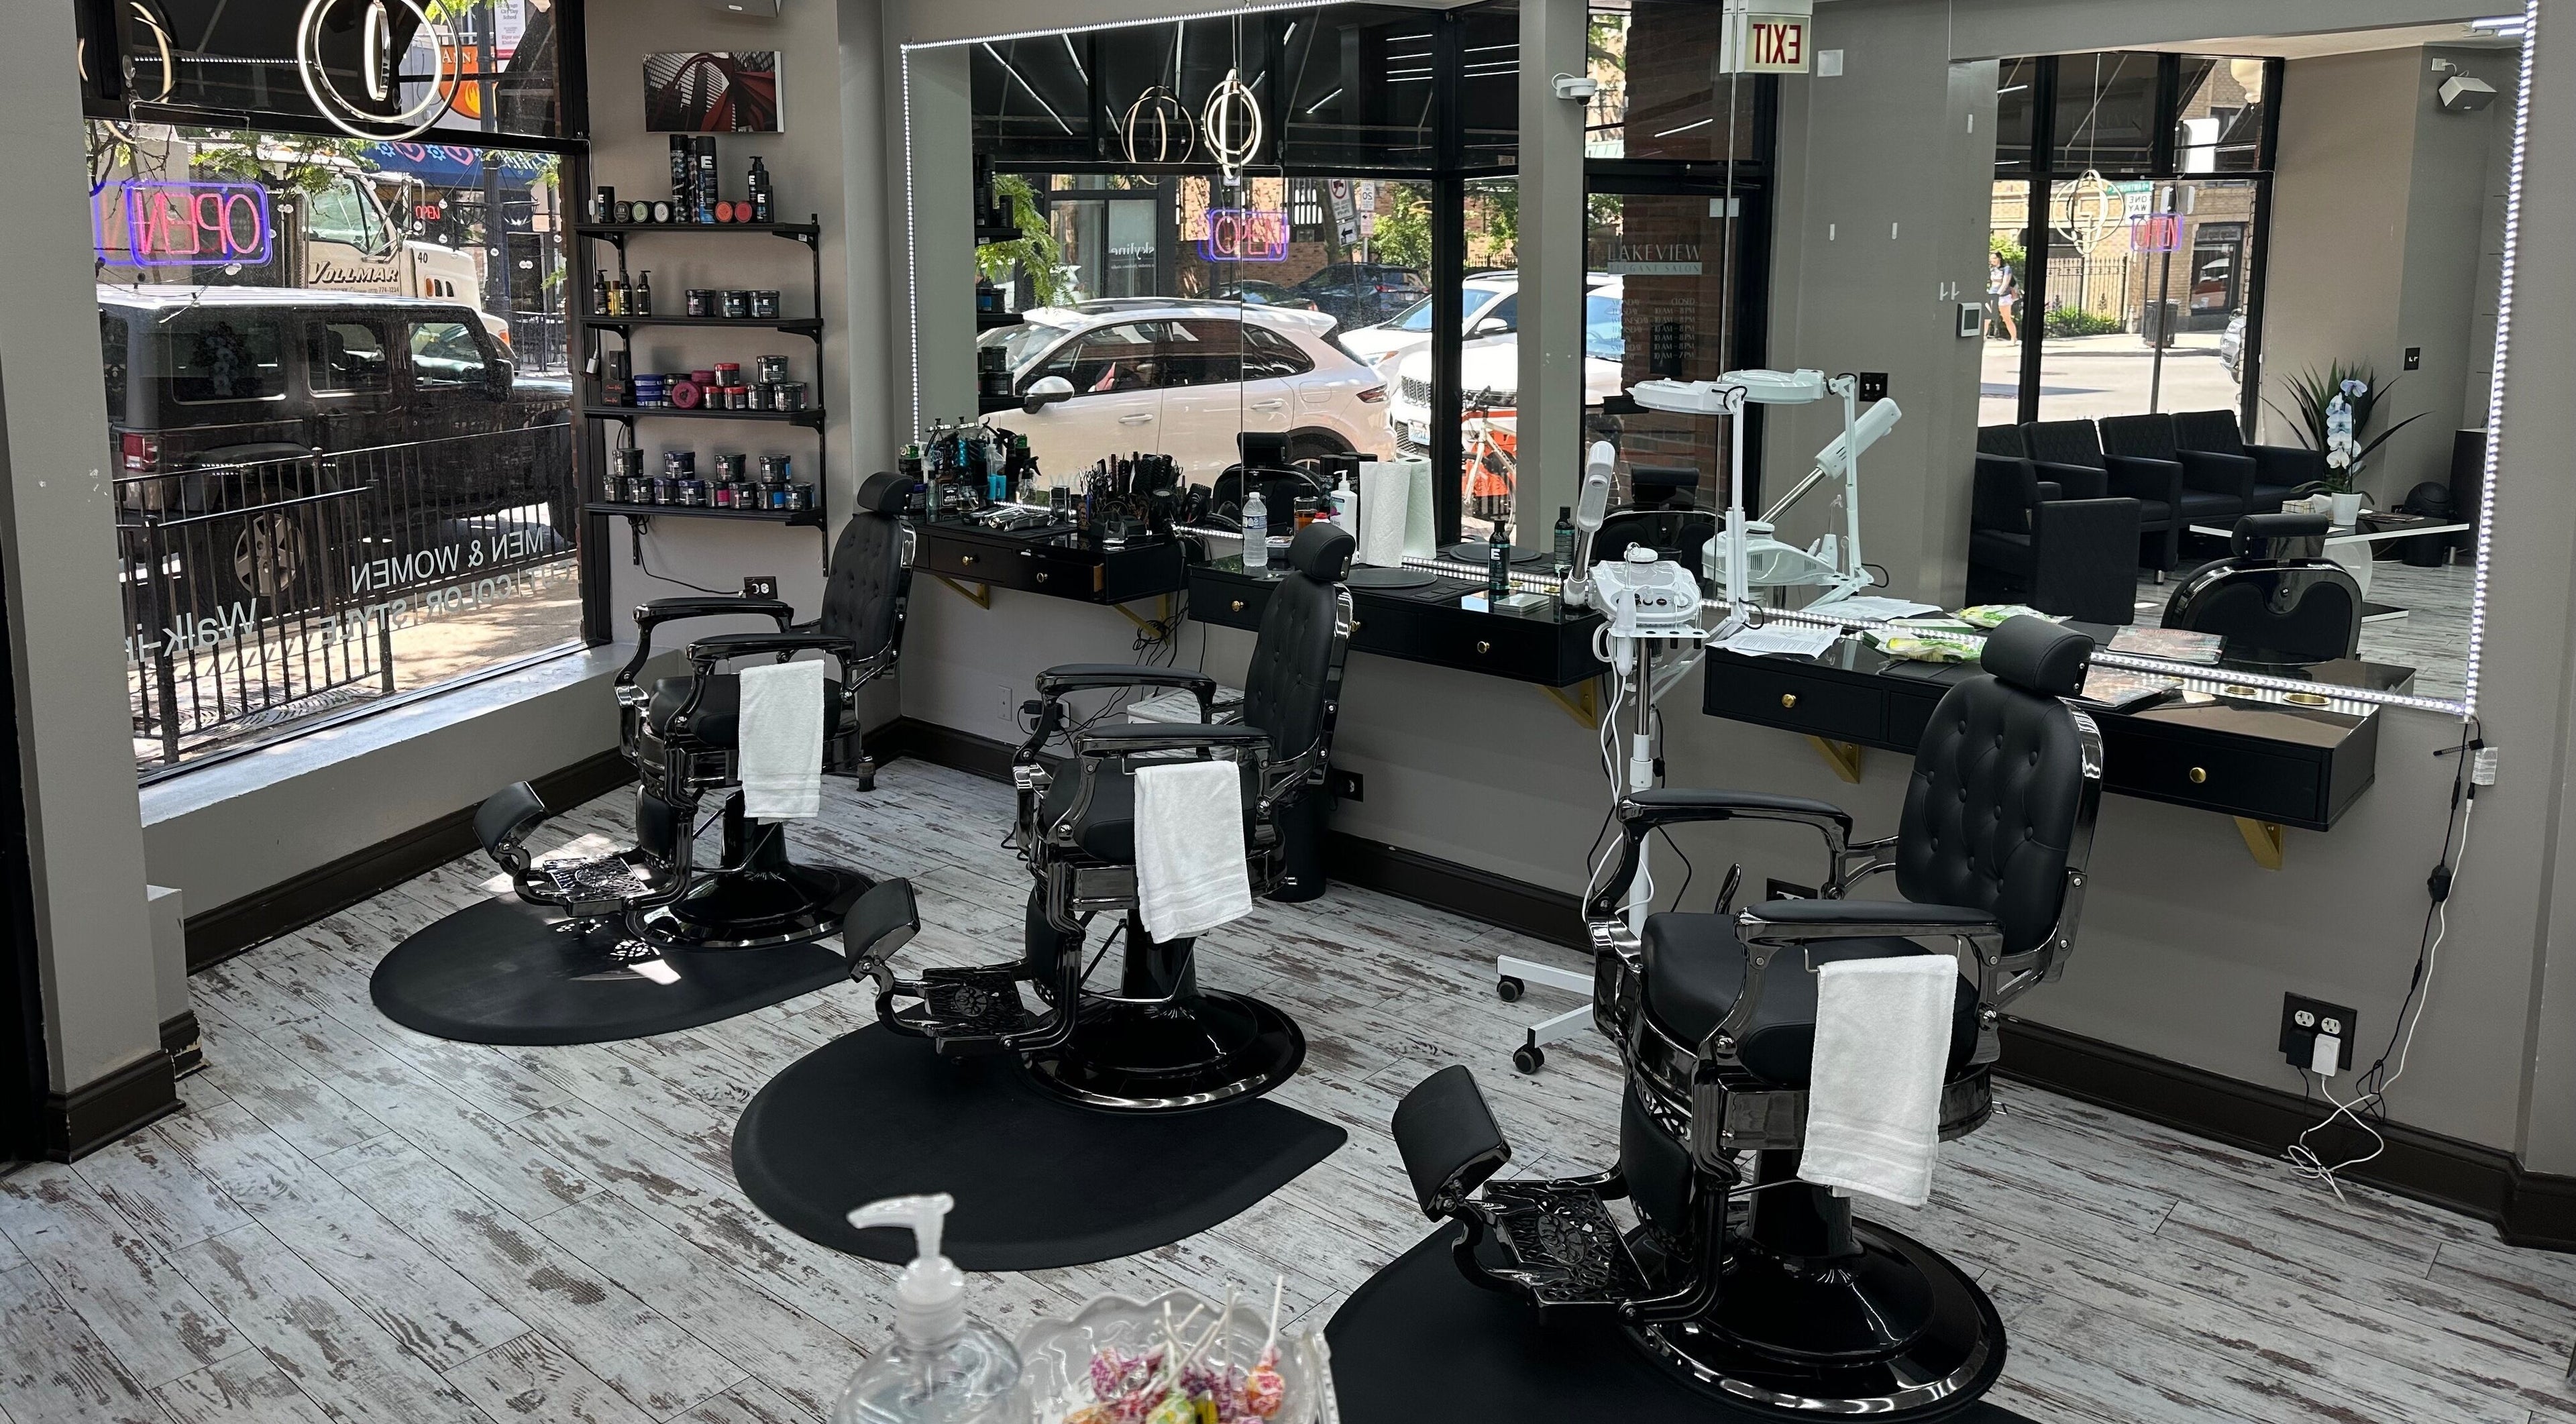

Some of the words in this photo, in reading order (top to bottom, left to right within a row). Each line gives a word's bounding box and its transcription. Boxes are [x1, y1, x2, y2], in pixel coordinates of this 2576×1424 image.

[415, 205, 441, 220] OPEN
[1216, 216, 1282, 254] OPEN
[2136, 218, 2178, 247] OPEN
[418, 252, 427, 263] 40
[1608, 244, 1702, 261] LAKEVIEW
[309, 261, 398, 284] VOLLMAR
[1665, 264, 1699, 272] SALON
[1491, 548, 1501, 560] E
